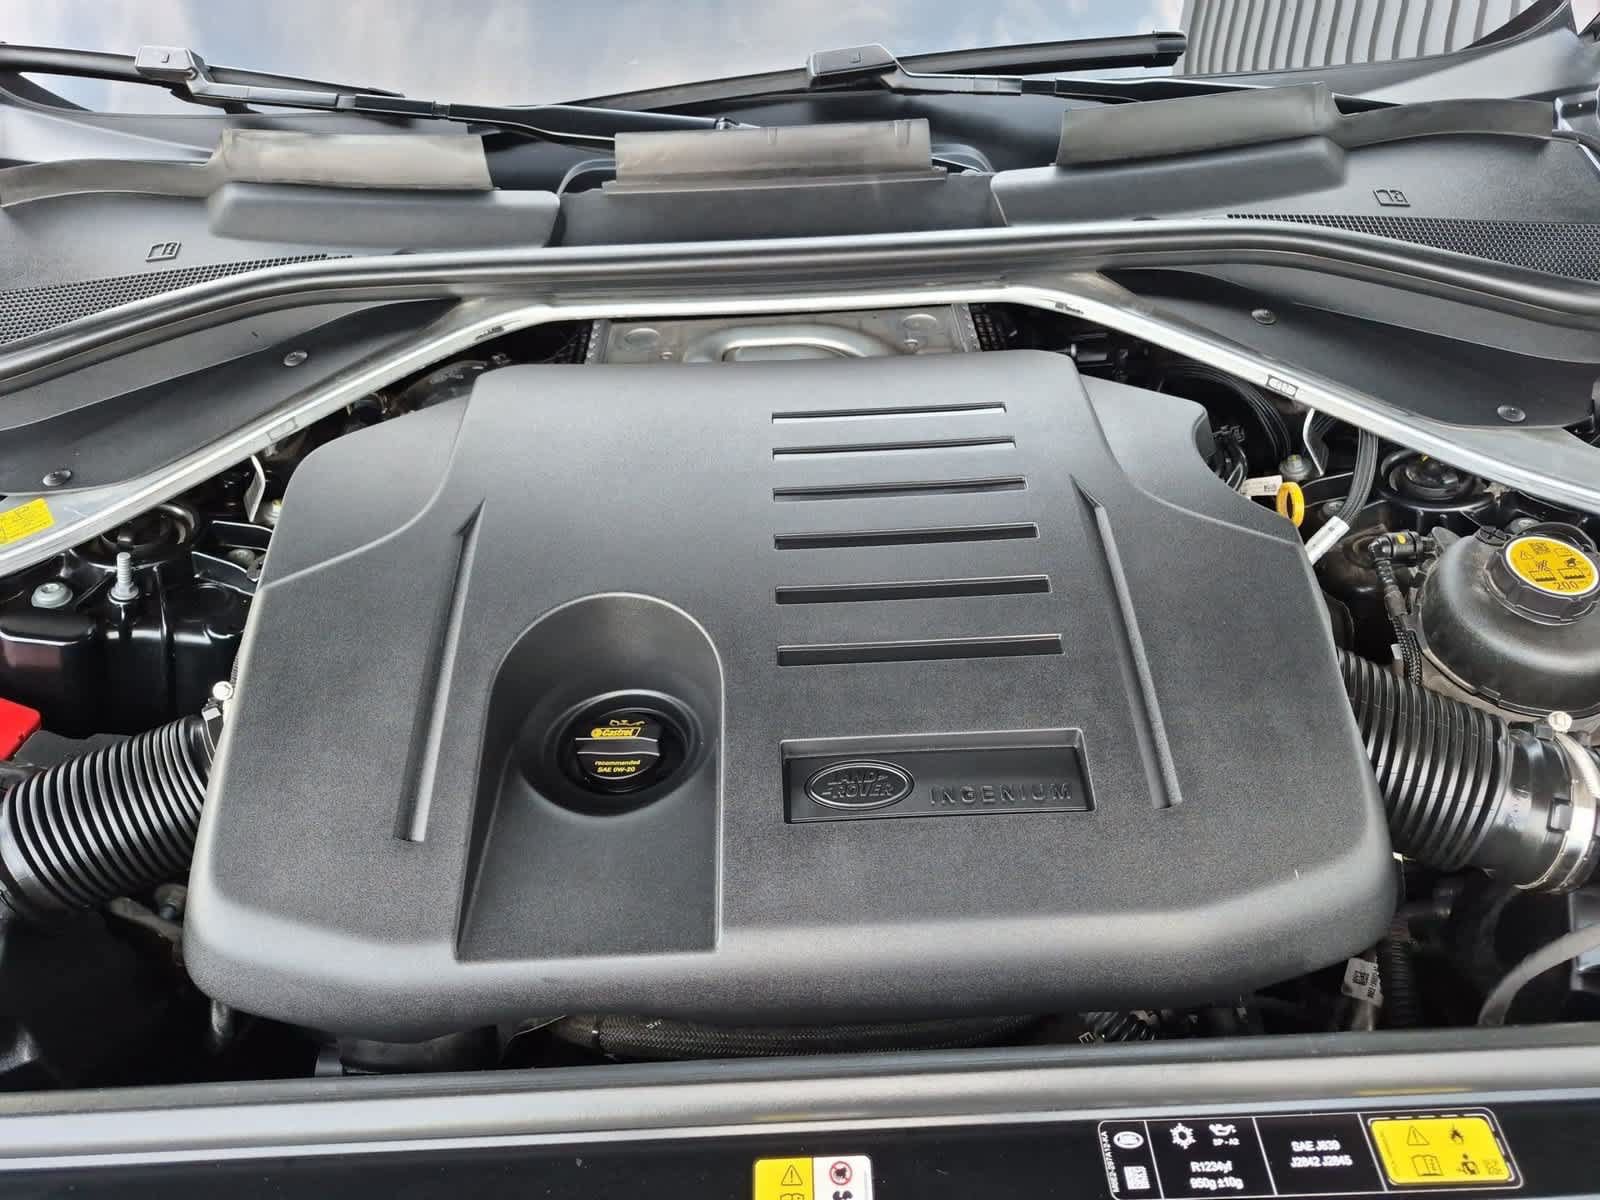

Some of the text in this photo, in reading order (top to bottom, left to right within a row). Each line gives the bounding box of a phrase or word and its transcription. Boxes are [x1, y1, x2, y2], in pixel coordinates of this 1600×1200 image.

[603, 728, 632, 737] Castrol
[827, 770, 881, 785] LAND
[829, 782, 895, 799] ROVER
[928, 783, 1073, 806] INGENIUM
[1291, 1141, 1315, 1152] SAE
[1190, 1161, 1232, 1173] R1234yf
